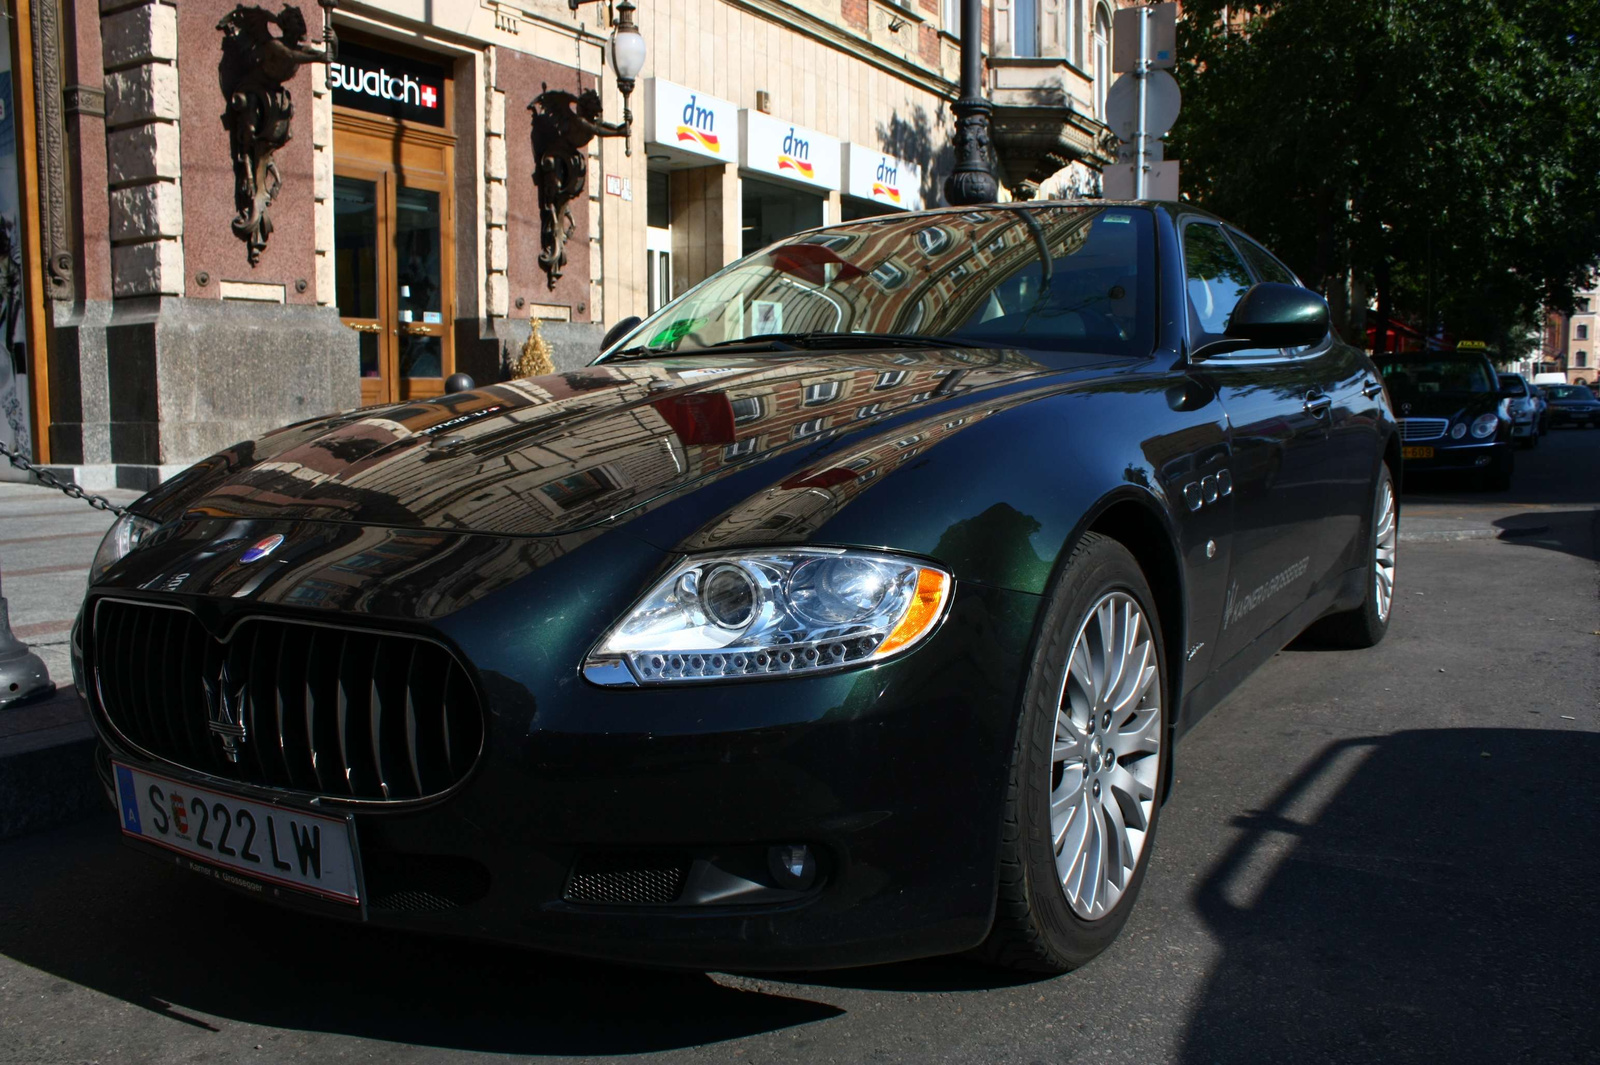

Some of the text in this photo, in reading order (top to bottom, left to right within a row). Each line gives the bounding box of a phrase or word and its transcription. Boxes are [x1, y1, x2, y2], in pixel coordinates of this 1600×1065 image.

[331, 62, 420, 106] swatch
[683, 95, 714, 132] dm
[782, 127, 810, 160] dm
[876, 157, 897, 186] dm
[128, 808, 136, 823] A
